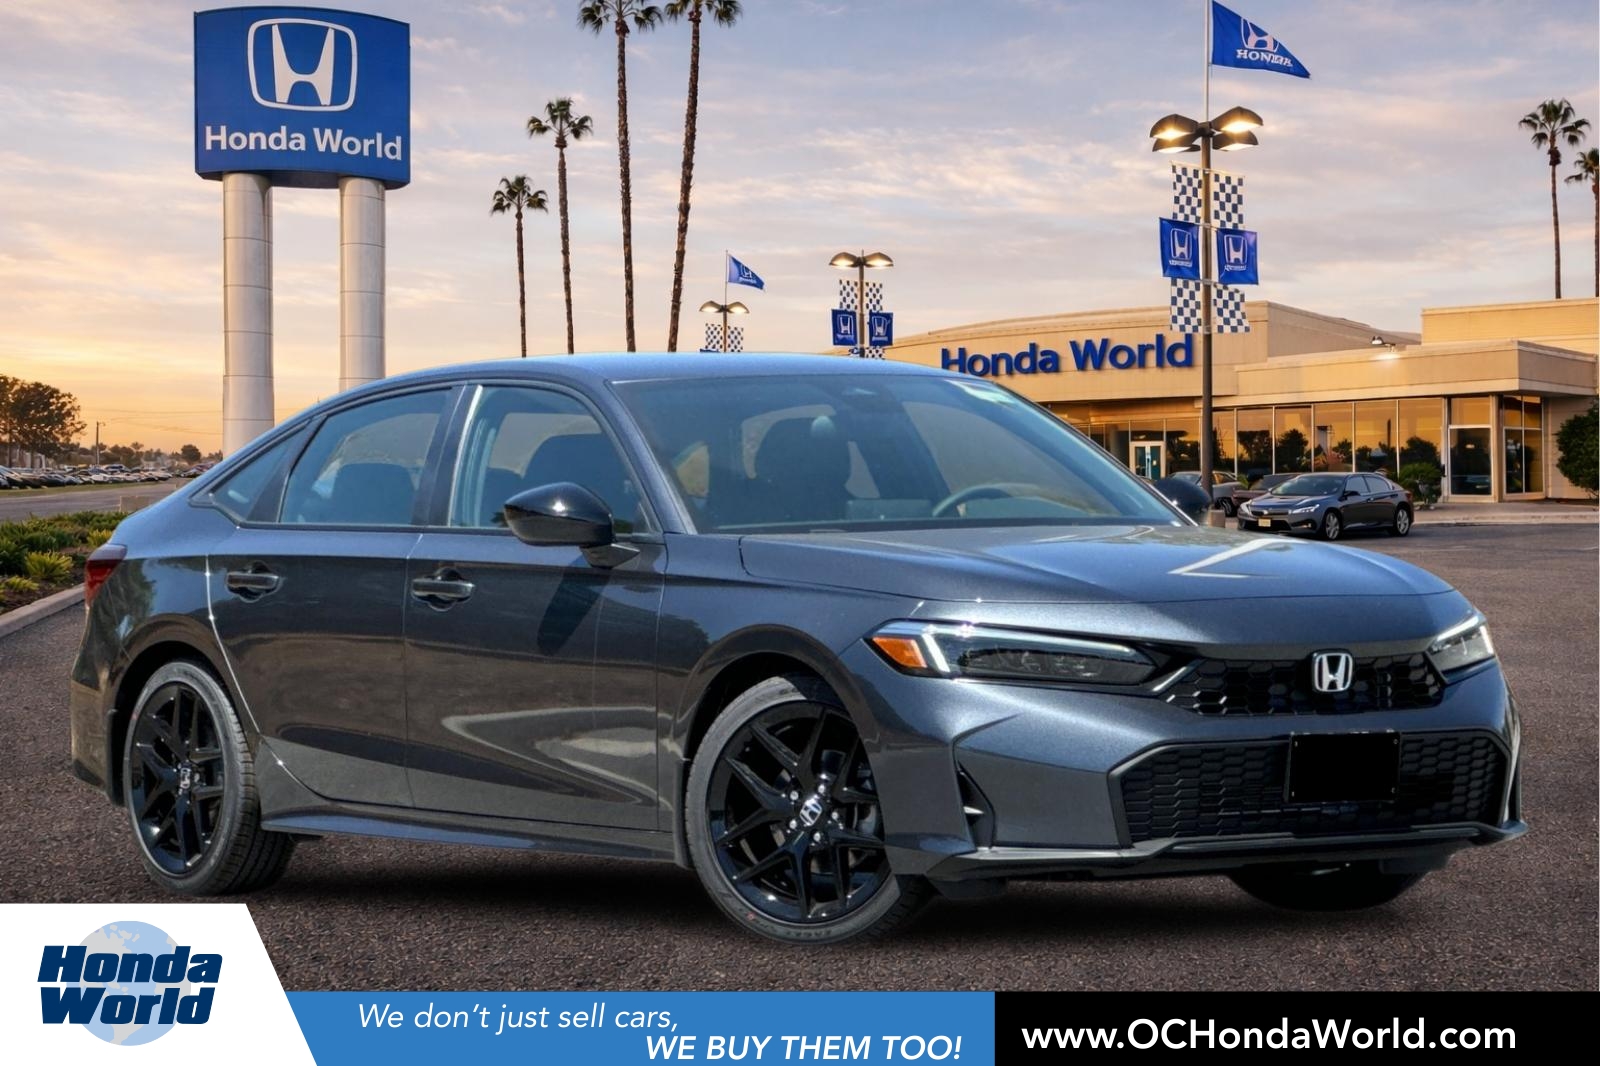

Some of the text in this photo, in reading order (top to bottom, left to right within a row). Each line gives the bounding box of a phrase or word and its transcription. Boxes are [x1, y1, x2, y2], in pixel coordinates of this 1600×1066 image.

[206, 126, 401, 160] Honda World
[941, 333, 1194, 377] Honda World
